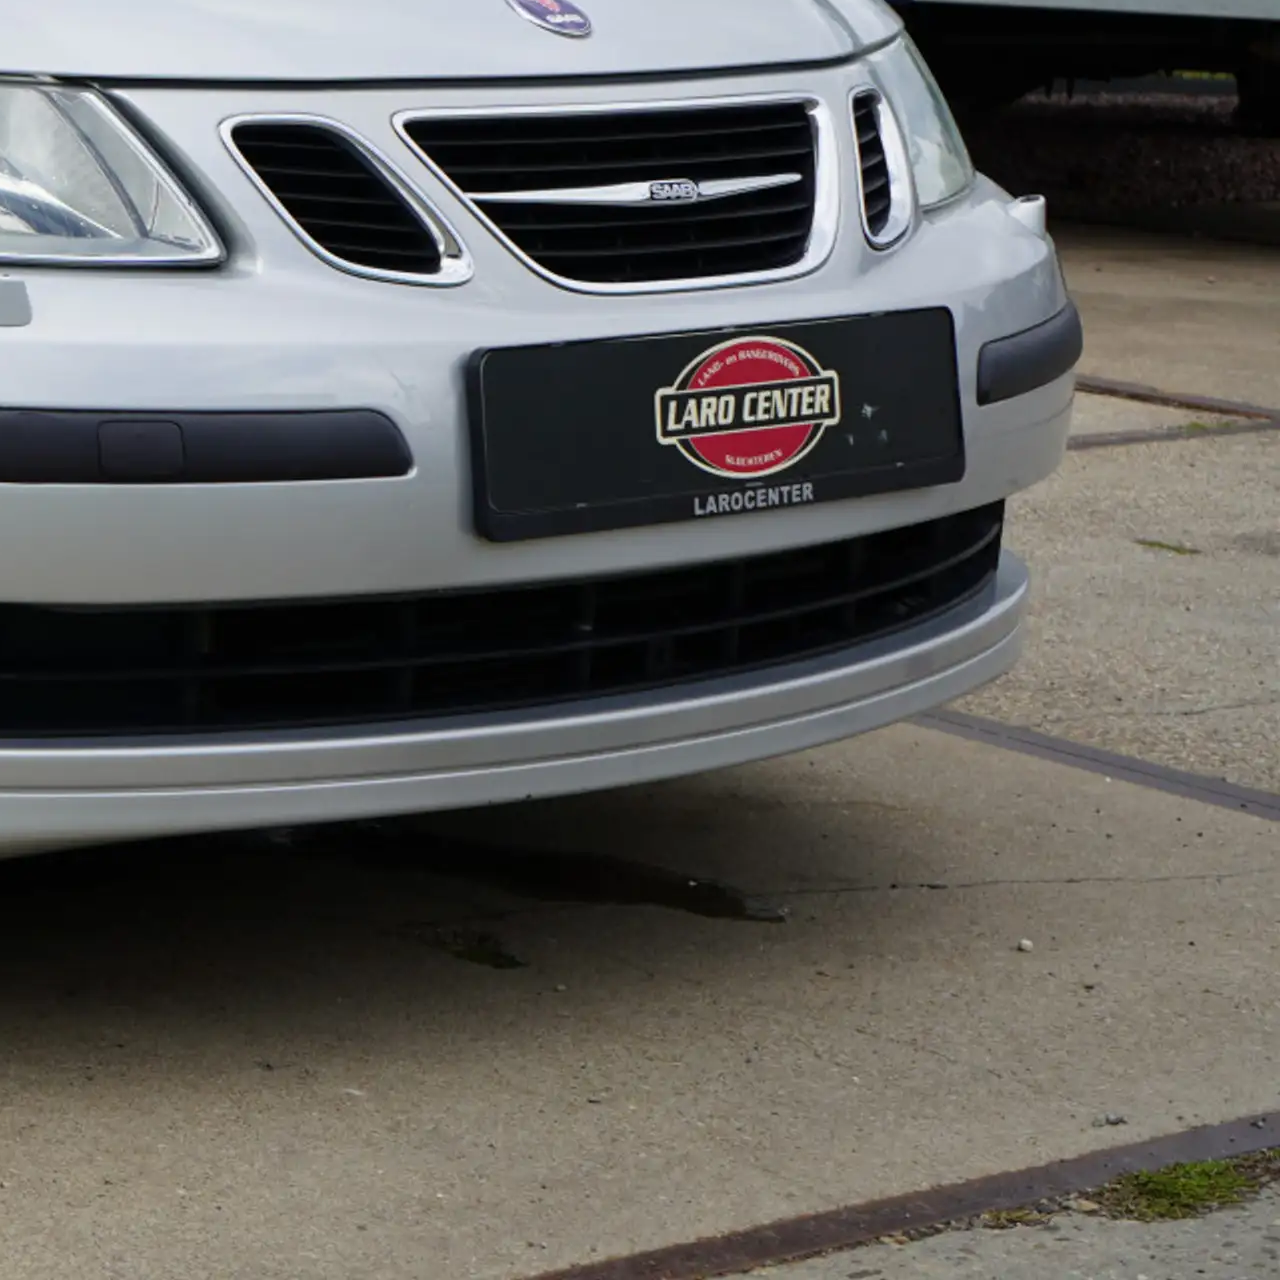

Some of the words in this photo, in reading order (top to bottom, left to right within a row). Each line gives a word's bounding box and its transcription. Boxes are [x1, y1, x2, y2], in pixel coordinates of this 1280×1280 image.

[650, 182, 694, 199] SAAB
[666, 394, 736, 431] LARO
[742, 384, 831, 422] CENTER
[694, 482, 814, 516] LAROCENTER
